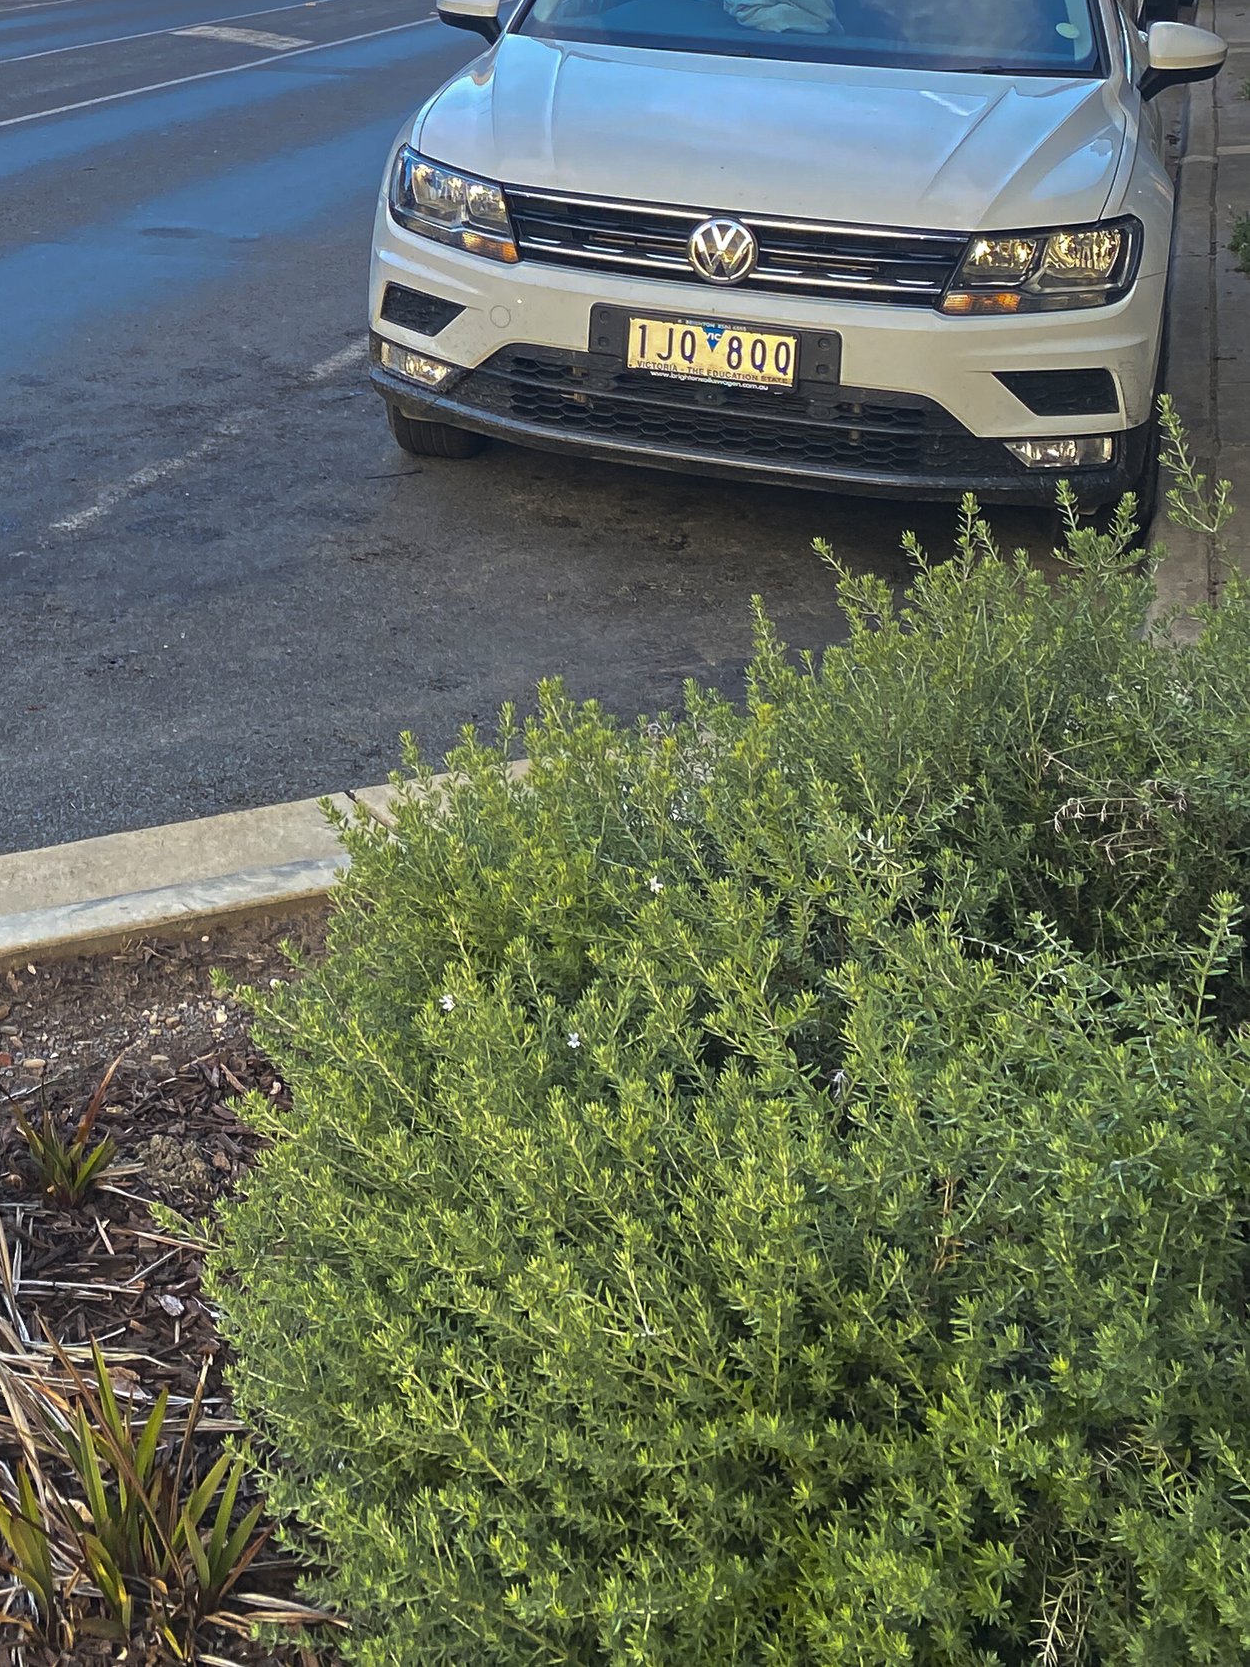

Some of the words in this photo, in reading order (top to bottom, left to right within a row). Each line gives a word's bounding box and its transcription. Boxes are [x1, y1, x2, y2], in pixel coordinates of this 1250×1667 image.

[638, 324, 697, 364] 1JQ
[706, 332, 722, 342] VIC
[726, 335, 791, 377] 8QQ
[636, 360, 679, 373] VICTORIA
[687, 367, 705, 377] THE
[706, 368, 760, 382] EDUCATION
[761, 375, 789, 385] STATE
